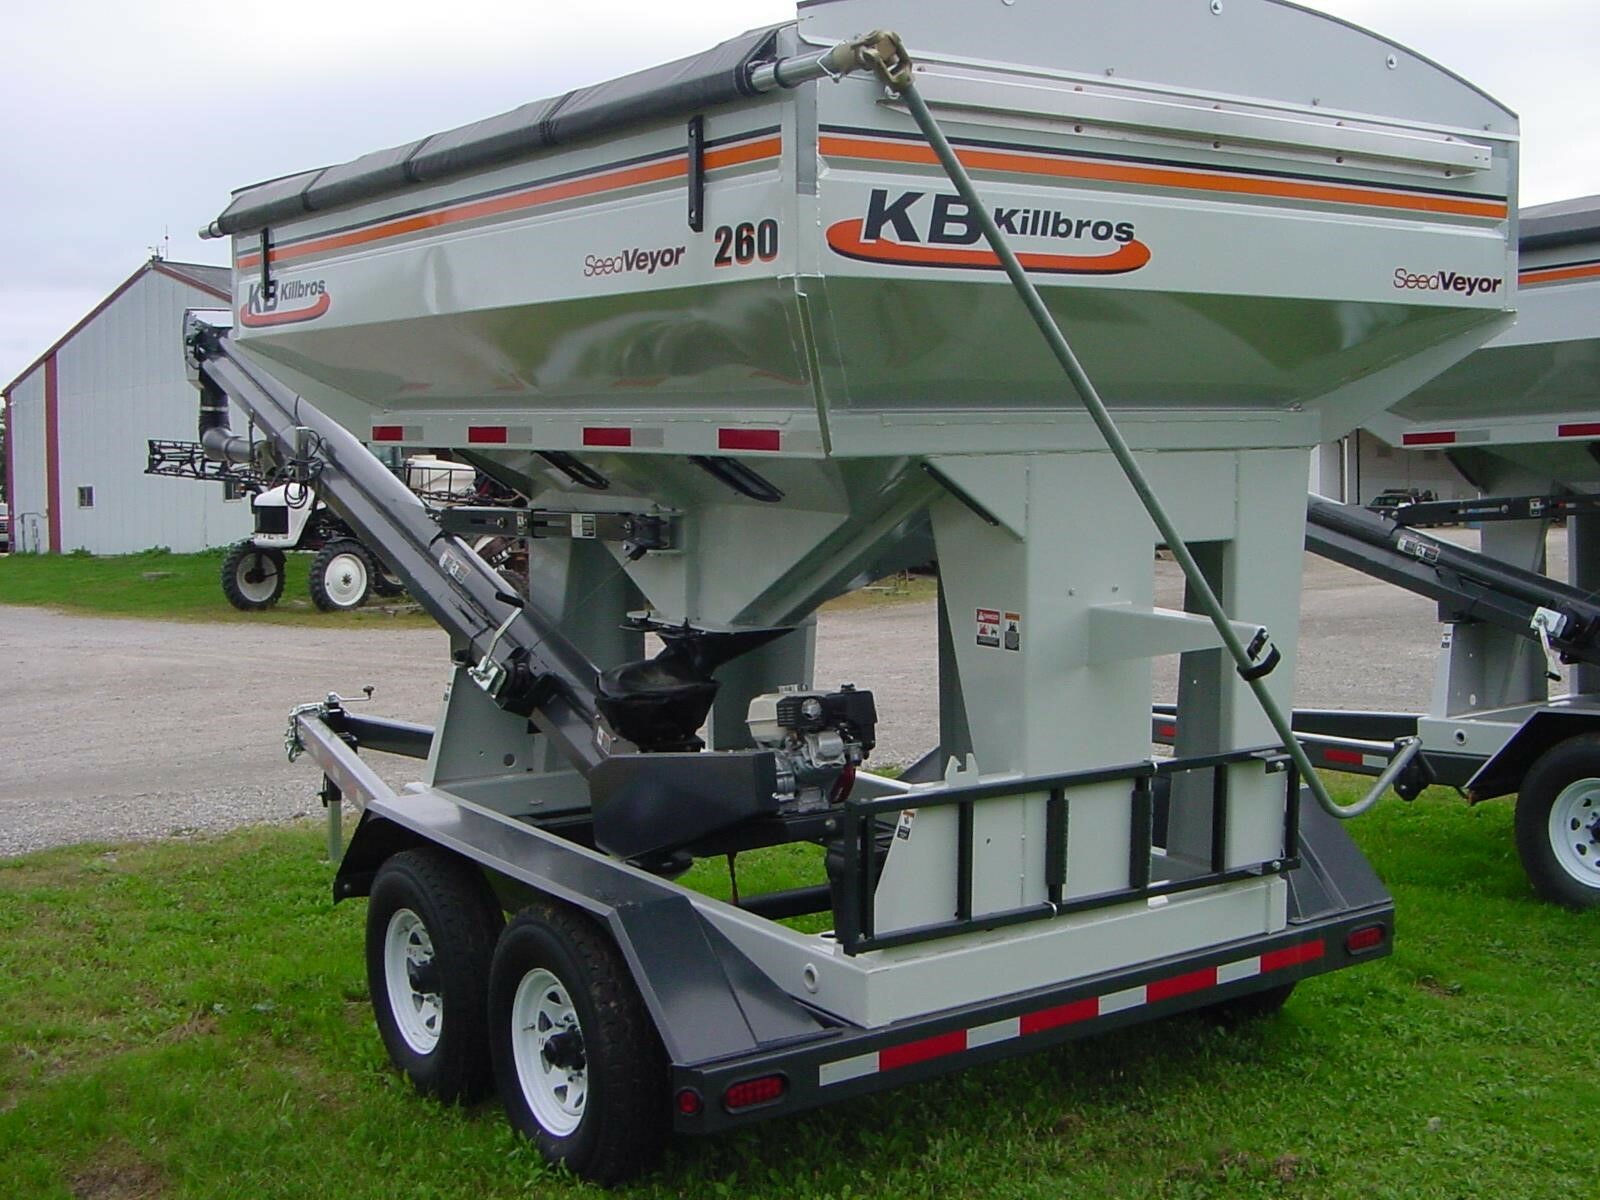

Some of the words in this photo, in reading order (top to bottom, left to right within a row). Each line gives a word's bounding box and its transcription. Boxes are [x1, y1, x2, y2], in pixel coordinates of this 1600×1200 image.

[863, 188, 983, 245] KB
[993, 207, 1136, 243] Killbros
[714, 218, 779, 268] 260
[583, 246, 686, 277] SeedVeyor
[248, 279, 280, 315] KB
[280, 279, 326, 301] Killbros
[1393, 267, 1503, 297] SeedVeyor
